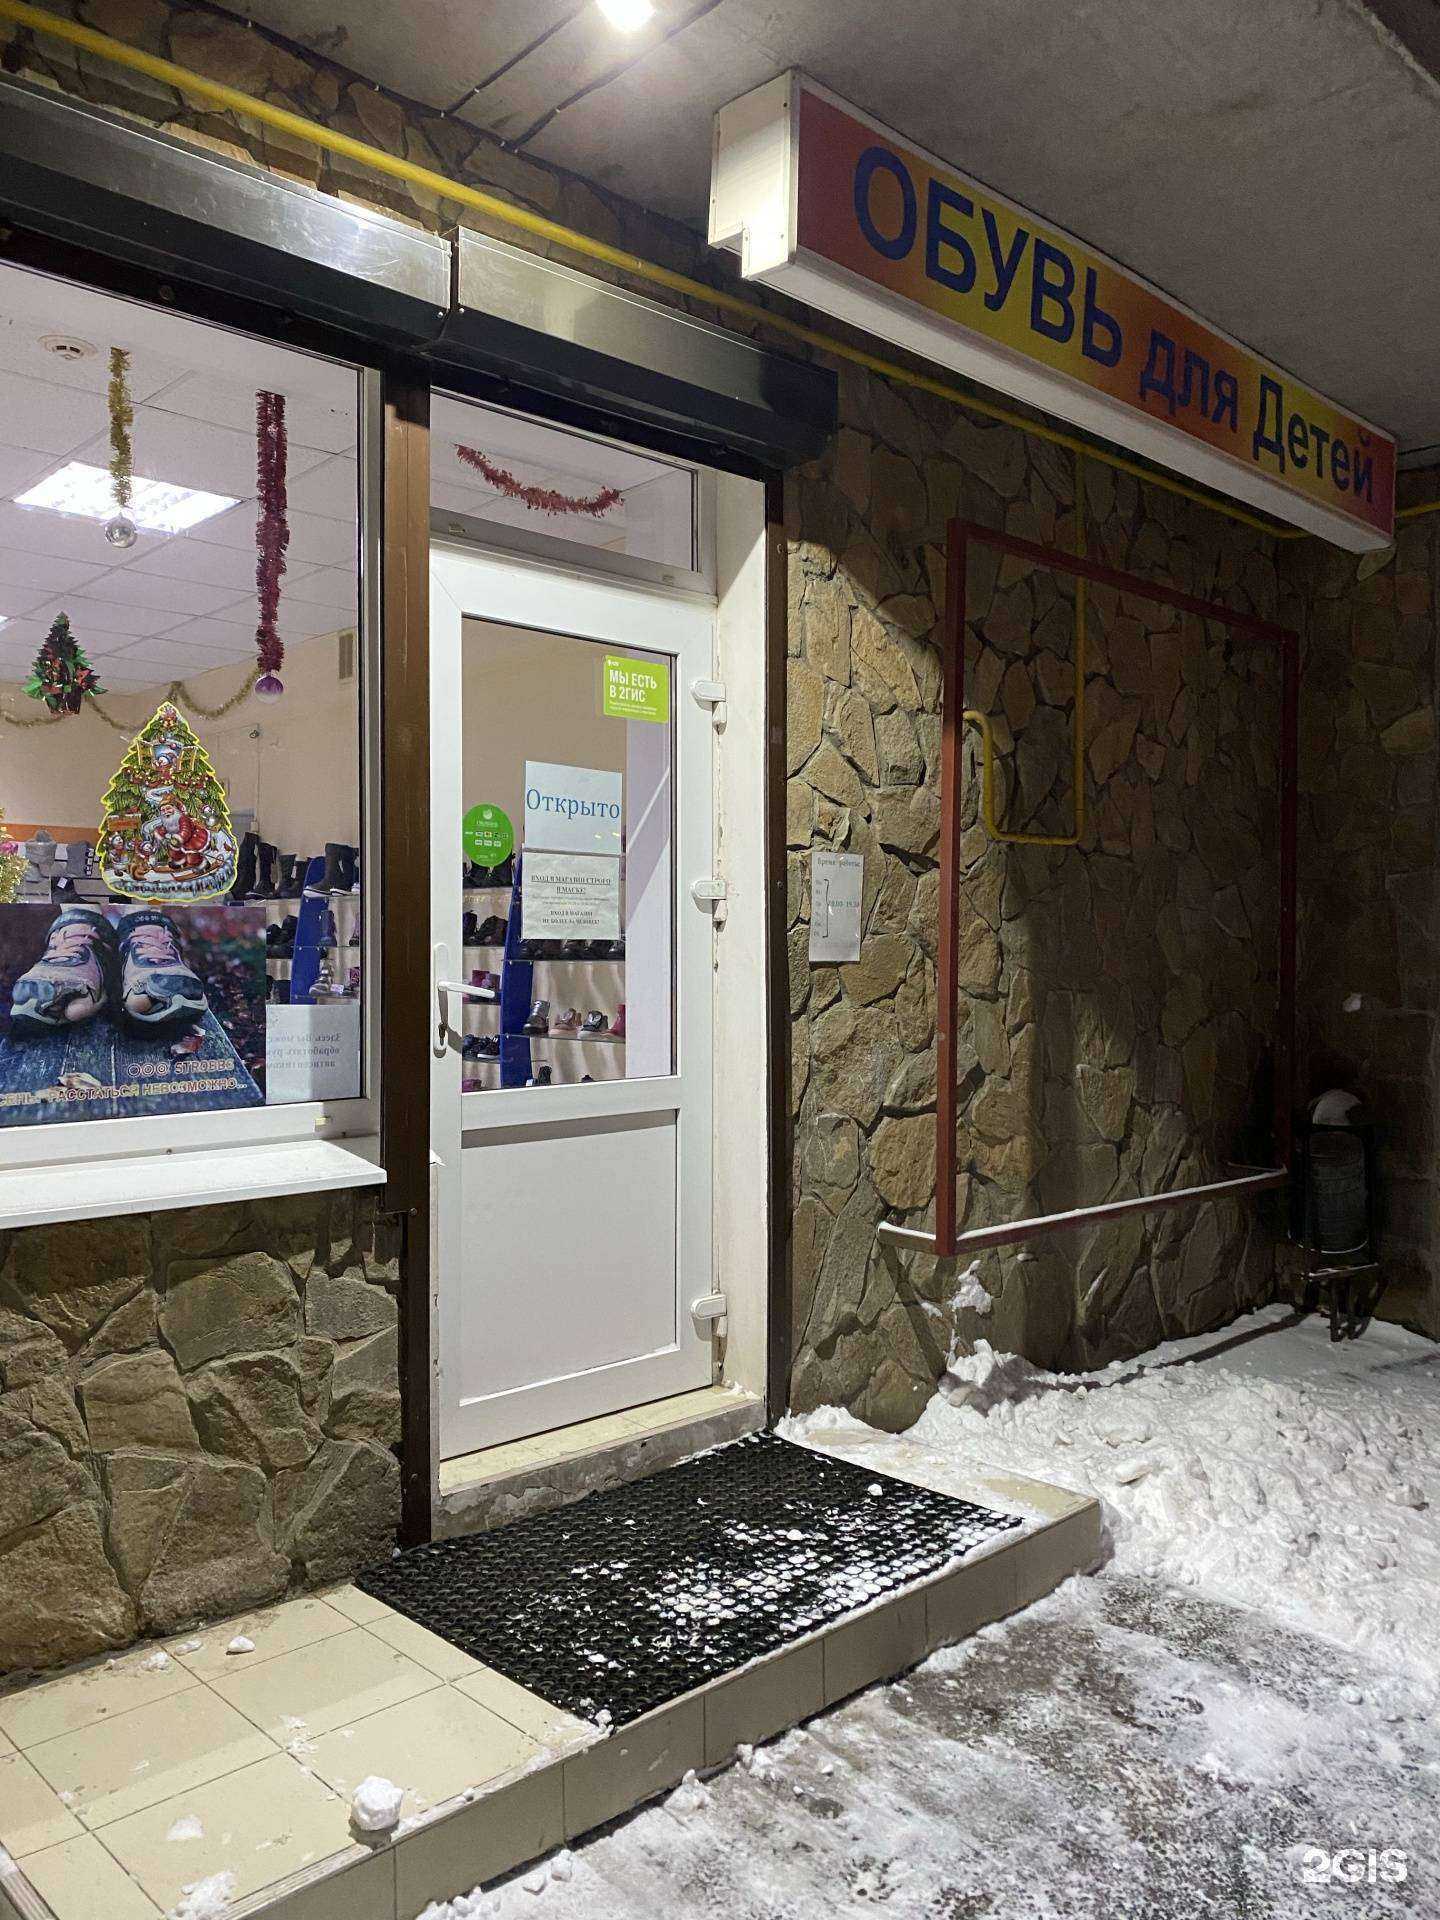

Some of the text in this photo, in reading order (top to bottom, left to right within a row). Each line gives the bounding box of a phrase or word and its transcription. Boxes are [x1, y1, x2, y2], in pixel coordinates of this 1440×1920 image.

[854, 147, 1374, 503] ОБУВЬ для Детей
[609, 669, 657, 689] МЫ ЕСТЬ
[609, 685, 646, 703] В 2ГИС
[526, 788, 620, 819] Открыто
